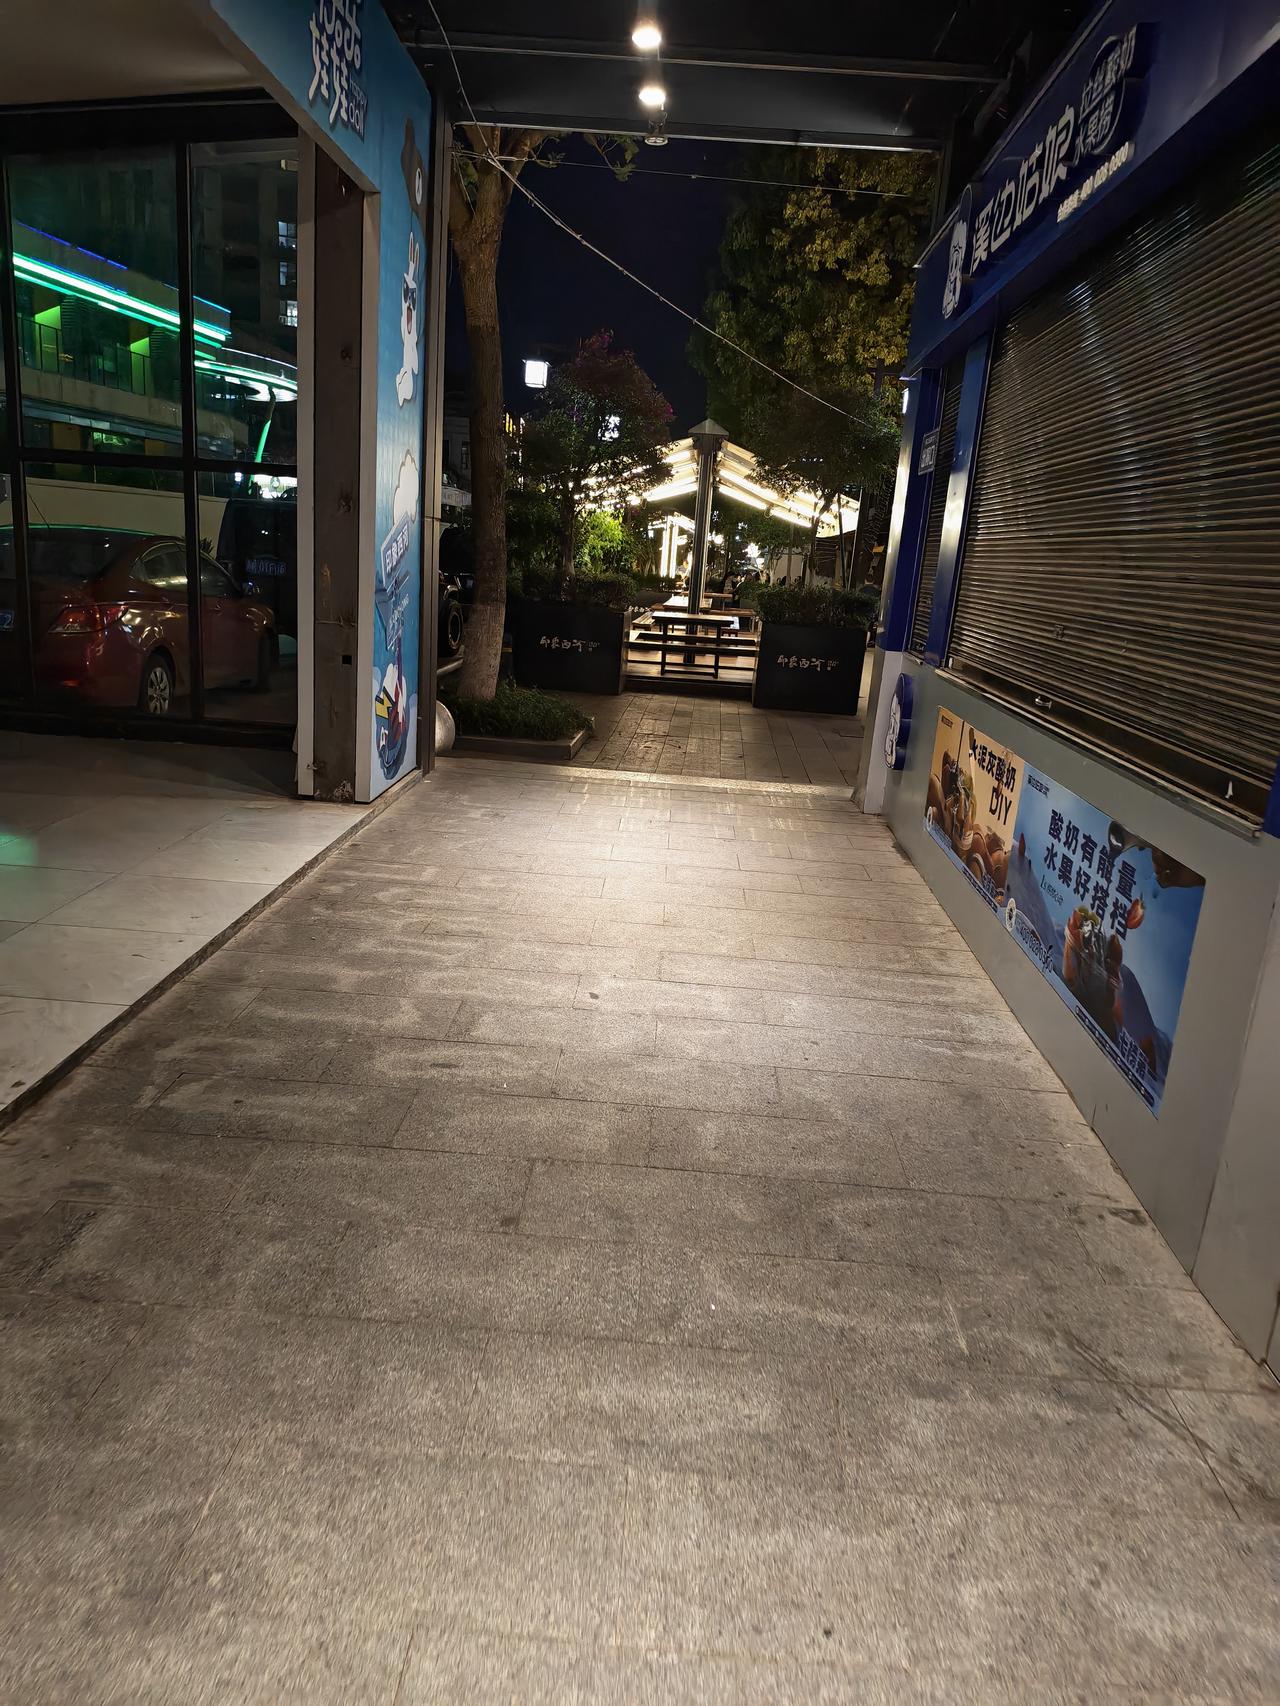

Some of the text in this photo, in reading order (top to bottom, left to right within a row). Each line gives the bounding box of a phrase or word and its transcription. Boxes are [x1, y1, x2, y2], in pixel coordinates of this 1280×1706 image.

[348, 100, 365, 138] doll
[989, 788, 1012, 825] DIY
[1048, 808, 1137, 903] 酸奶有能量
[1043, 842, 1130, 941] 水果好搭档
